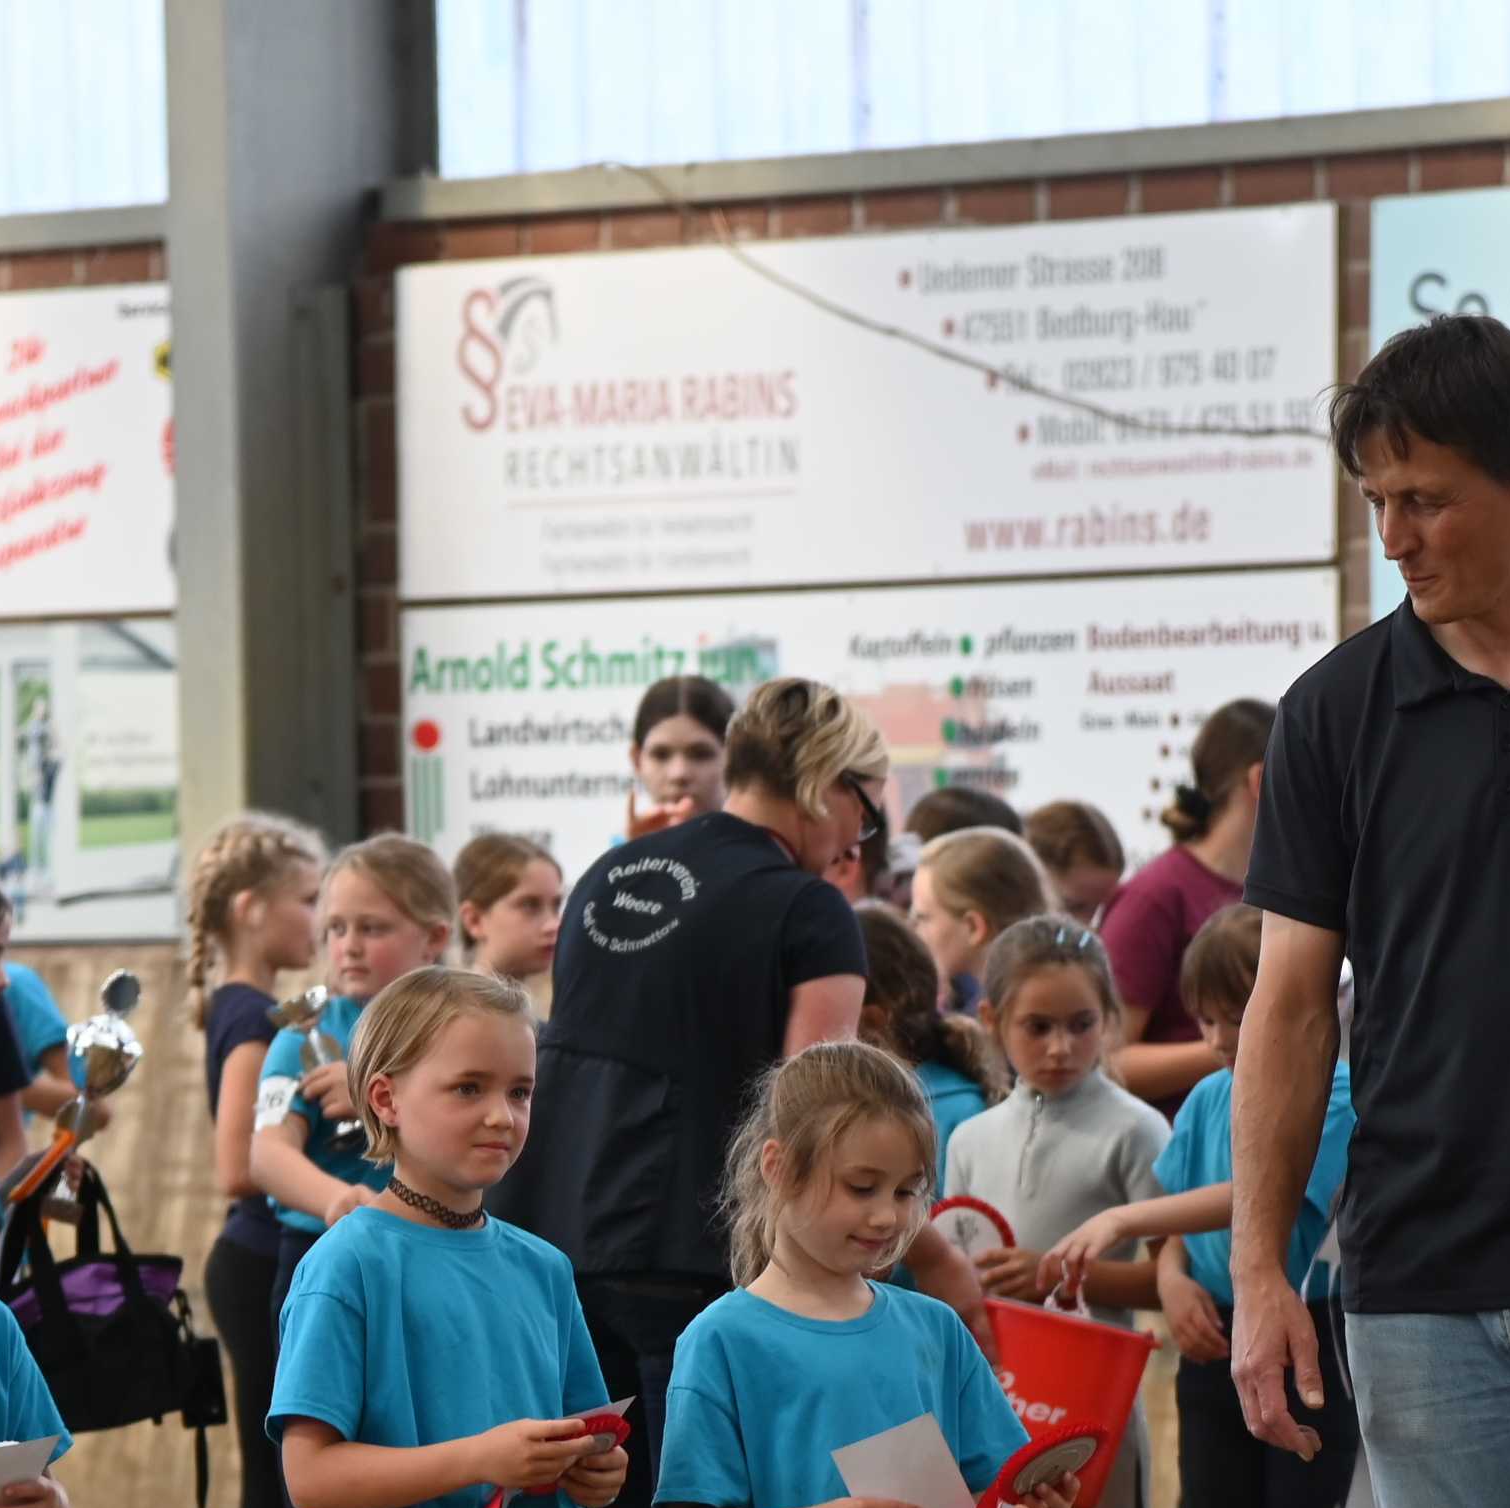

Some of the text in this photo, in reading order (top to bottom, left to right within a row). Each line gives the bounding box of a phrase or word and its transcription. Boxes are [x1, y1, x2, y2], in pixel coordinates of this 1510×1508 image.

[1028, 251, 1113, 288] Strasse
[506, 370, 798, 432] EVA-MARIA RABINS
[505, 427, 800, 488] RECHTSANWÄLTIN
[964, 503, 1211, 551] www.rabins.de
[1086, 620, 1301, 651] Bodenbearbeitung
[411, 641, 531, 693] Arnold
[542, 637, 684, 690] Schmitz
[1087, 670, 1174, 695] Aussaat
[608, 857, 697, 901] Reiterverein
[613, 889, 663, 915] Weeze
